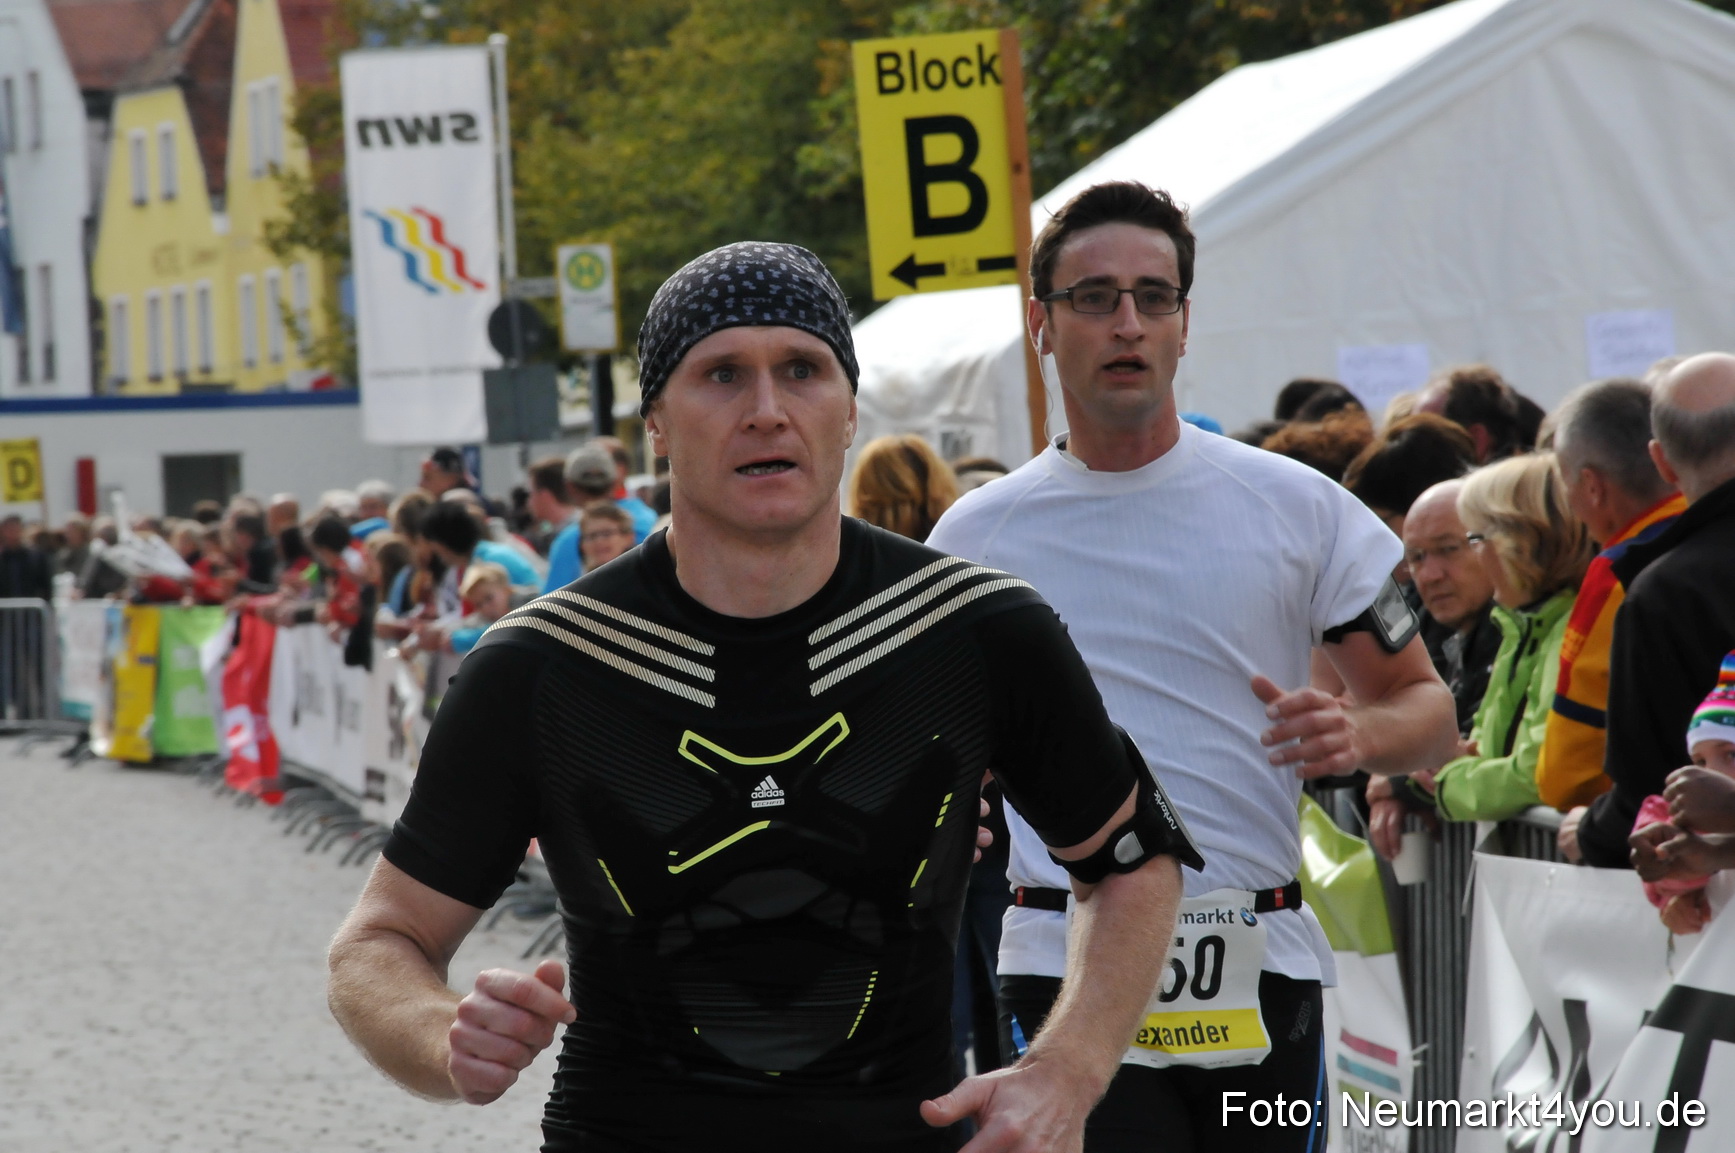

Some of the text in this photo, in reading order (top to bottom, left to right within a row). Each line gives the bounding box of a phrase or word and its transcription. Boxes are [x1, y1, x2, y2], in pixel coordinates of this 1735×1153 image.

[876, 43, 1002, 96] Block
[904, 115, 989, 239] B
[8, 457, 35, 492] D
[751, 789, 784, 798] adidas
[1153, 789, 1178, 831] runtastic
